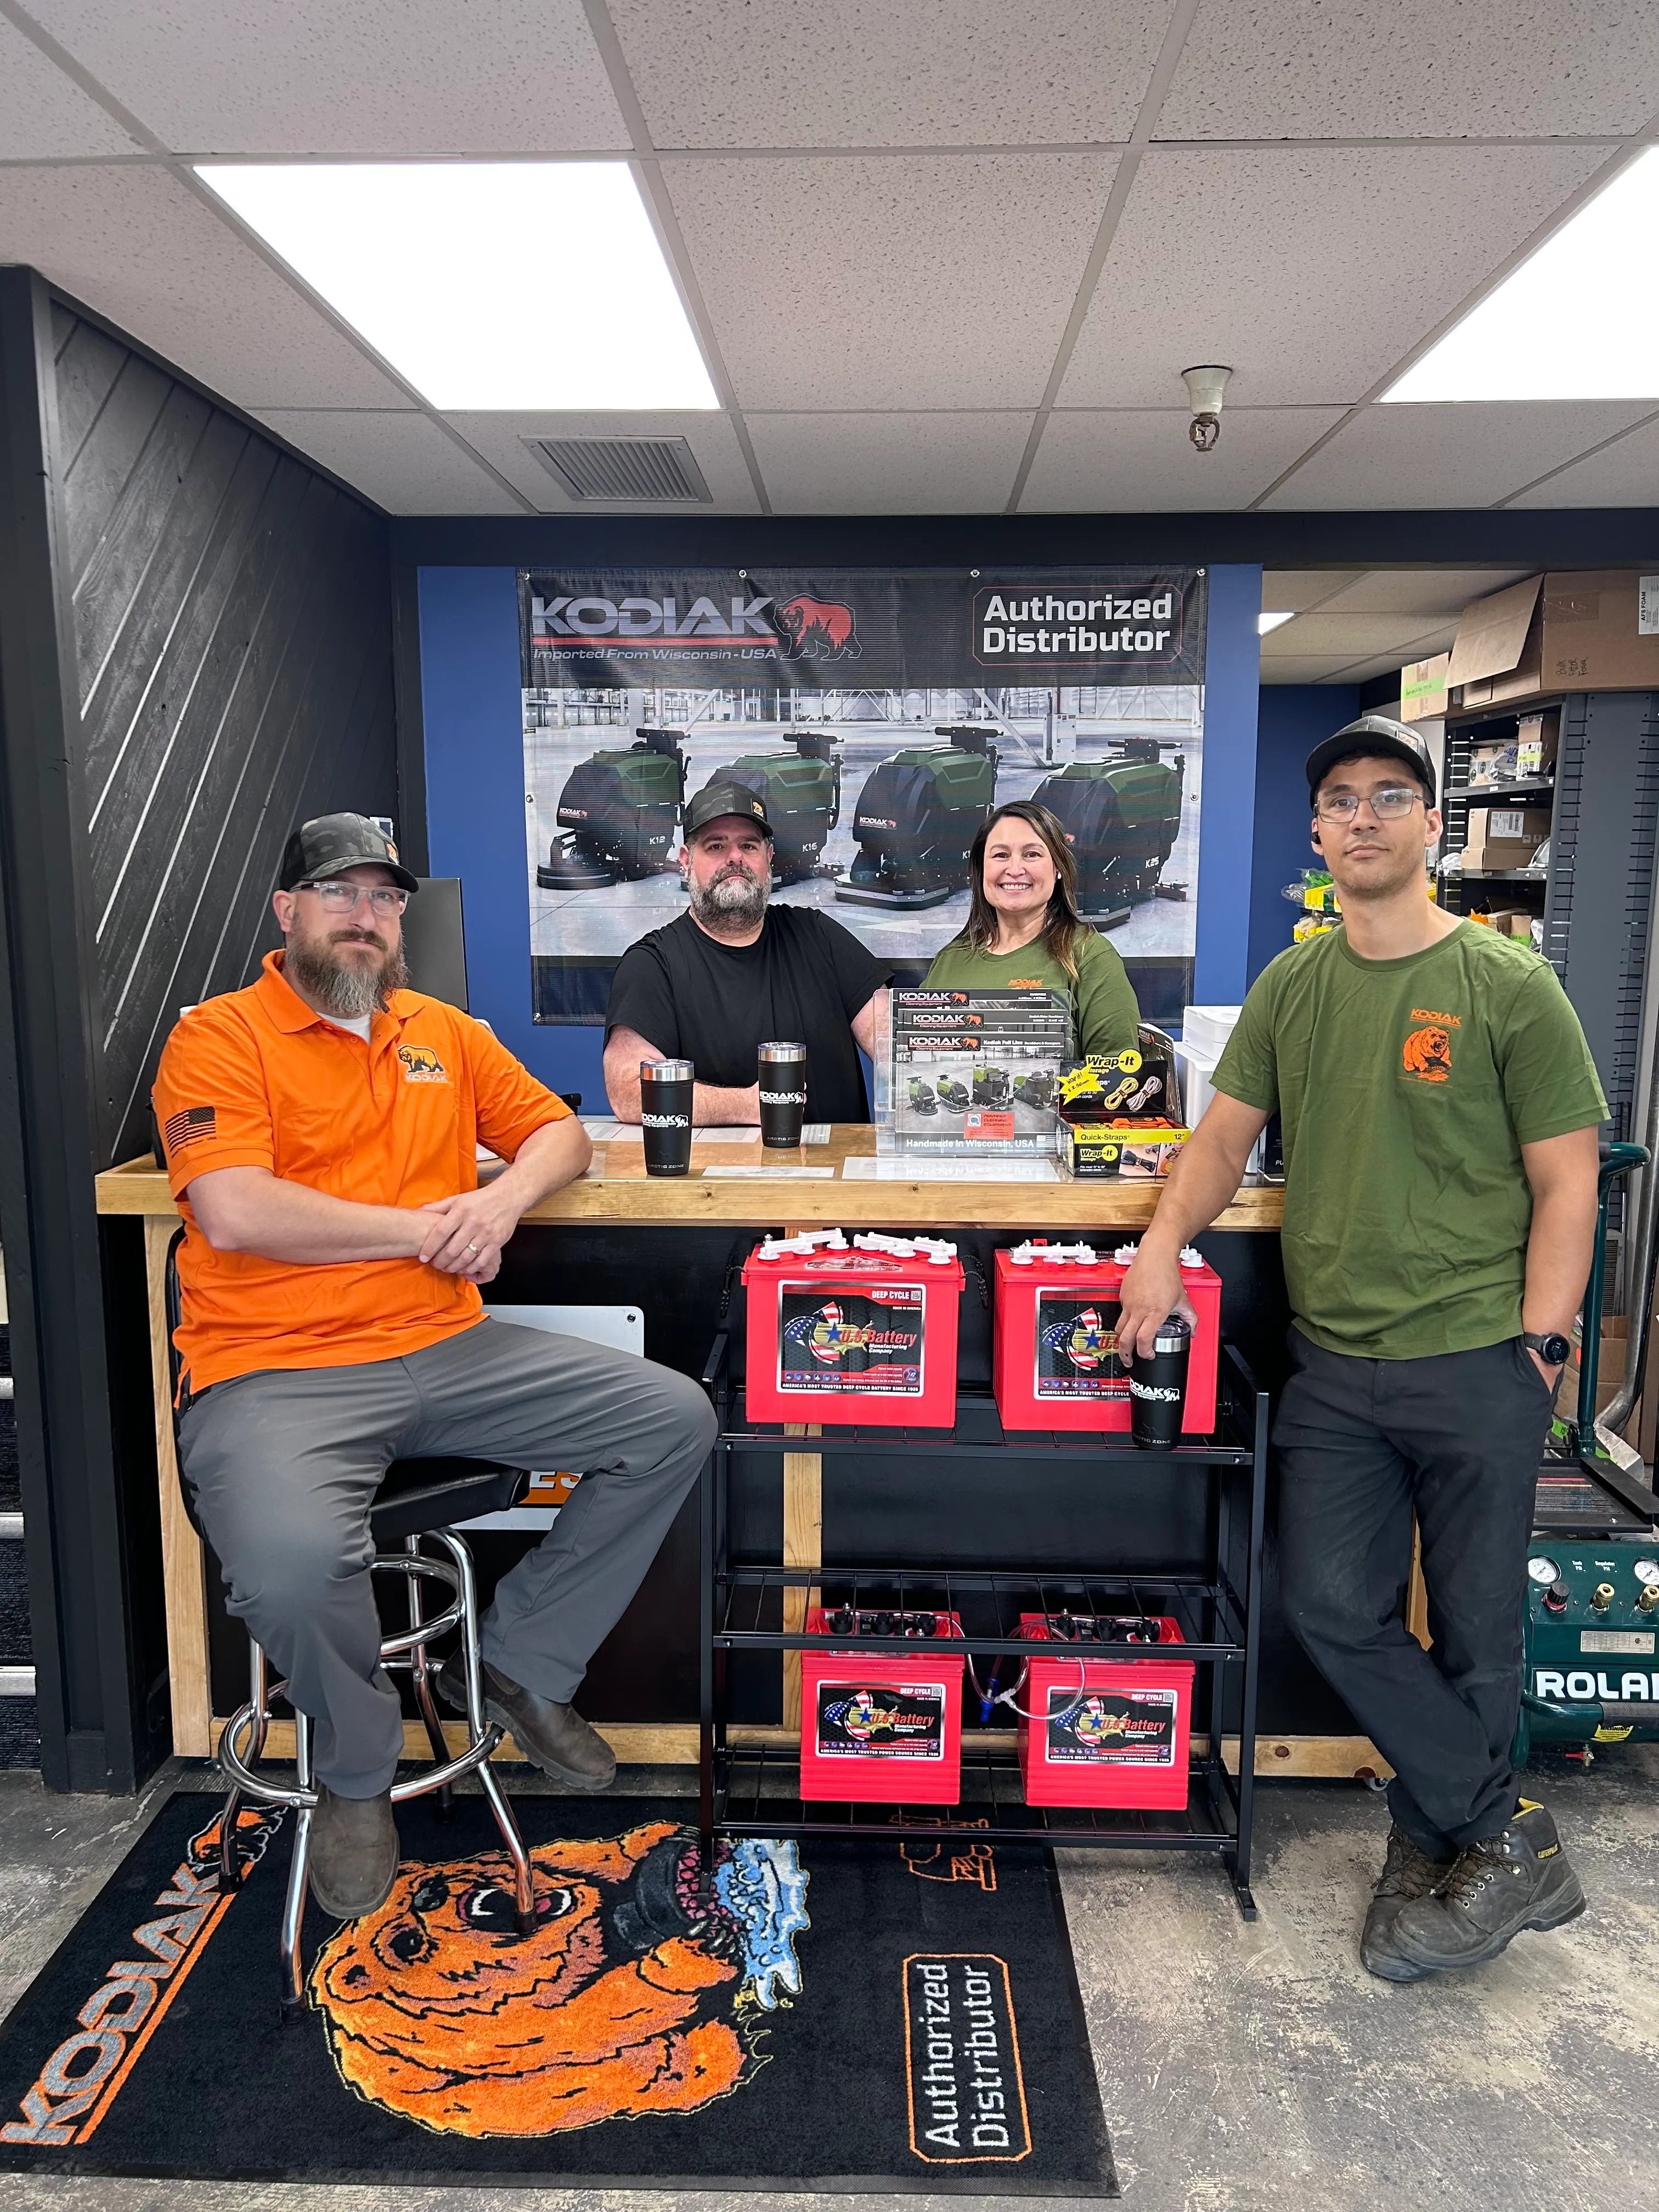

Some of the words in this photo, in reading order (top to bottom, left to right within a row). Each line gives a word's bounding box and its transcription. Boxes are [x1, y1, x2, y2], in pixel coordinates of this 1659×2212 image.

[984, 593, 1172, 621] Authorized
[532, 596, 777, 635] KODIAK
[983, 627, 1170, 653] Distributor
[534, 648, 603, 659] Imported
[607, 649, 651, 658] From
[652, 648, 731, 658] Wisconsin
[741, 648, 777, 659] USA
[859, 816, 888, 826] KODIAK
[649, 836, 665, 845] K12
[962, 849, 970, 860] K1
[899, 992, 950, 1001] KODIAK
[913, 1014, 964, 1023] KODIAK
[1412, 1008, 1461, 1024] KODIAK
[909, 1037, 961, 1046] KODIAK
[1087, 1056, 1135, 1067] Wrap-It
[642, 1113, 676, 1122] ODIAK
[1081, 1133, 1127, 1142] Quick-Straps
[906, 1139, 953, 1148] Handmade
[1081, 1149, 1113, 1158] Wrap-It
[872, 1290, 889, 1299] DEEP
[889, 1291, 910, 1300] CYCLE
[0, 1862, 222, 2146] KODIAK
[916, 1962, 961, 2147] Authorized
[963, 1964, 1009, 2147] Distributor
